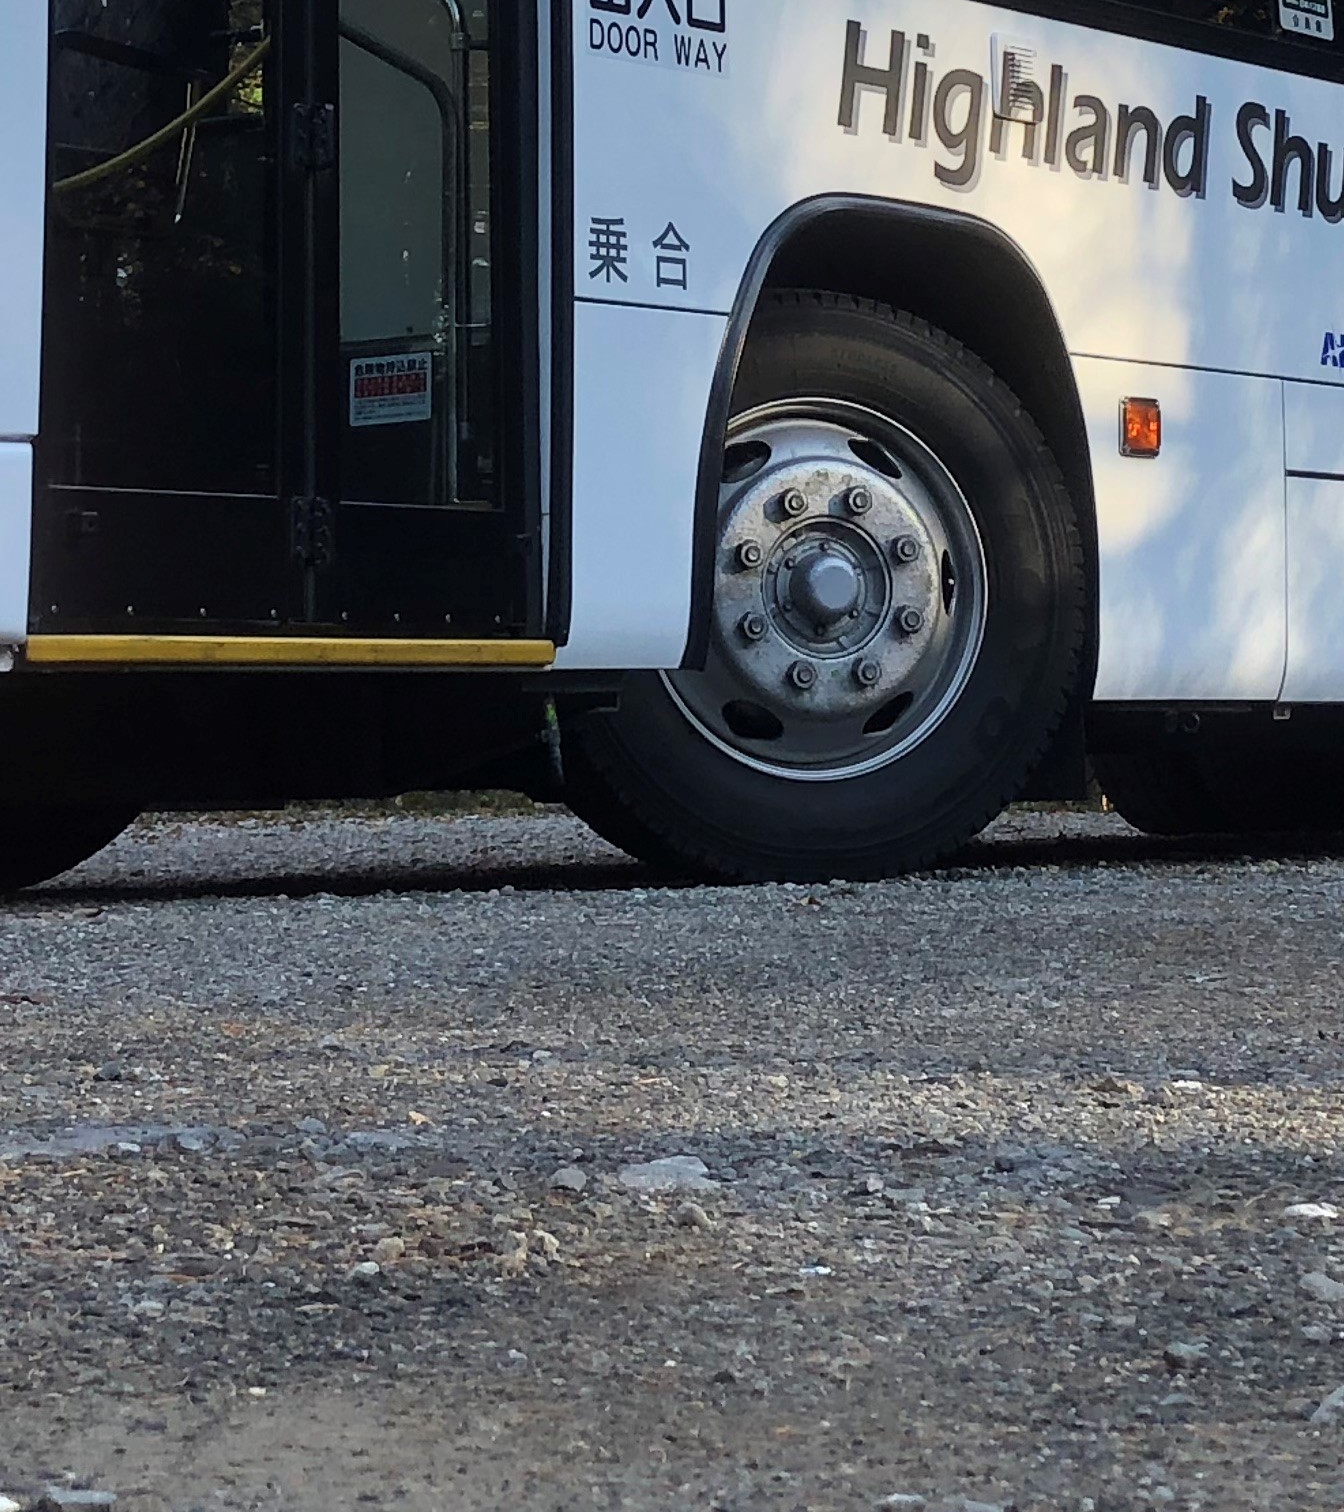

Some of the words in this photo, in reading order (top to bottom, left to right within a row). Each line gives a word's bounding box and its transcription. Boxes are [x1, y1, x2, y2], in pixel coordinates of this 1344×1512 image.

[589, 18, 659, 61] DOOR
[674, 33, 728, 73] WAY
[837, 19, 1210, 199] Highland
